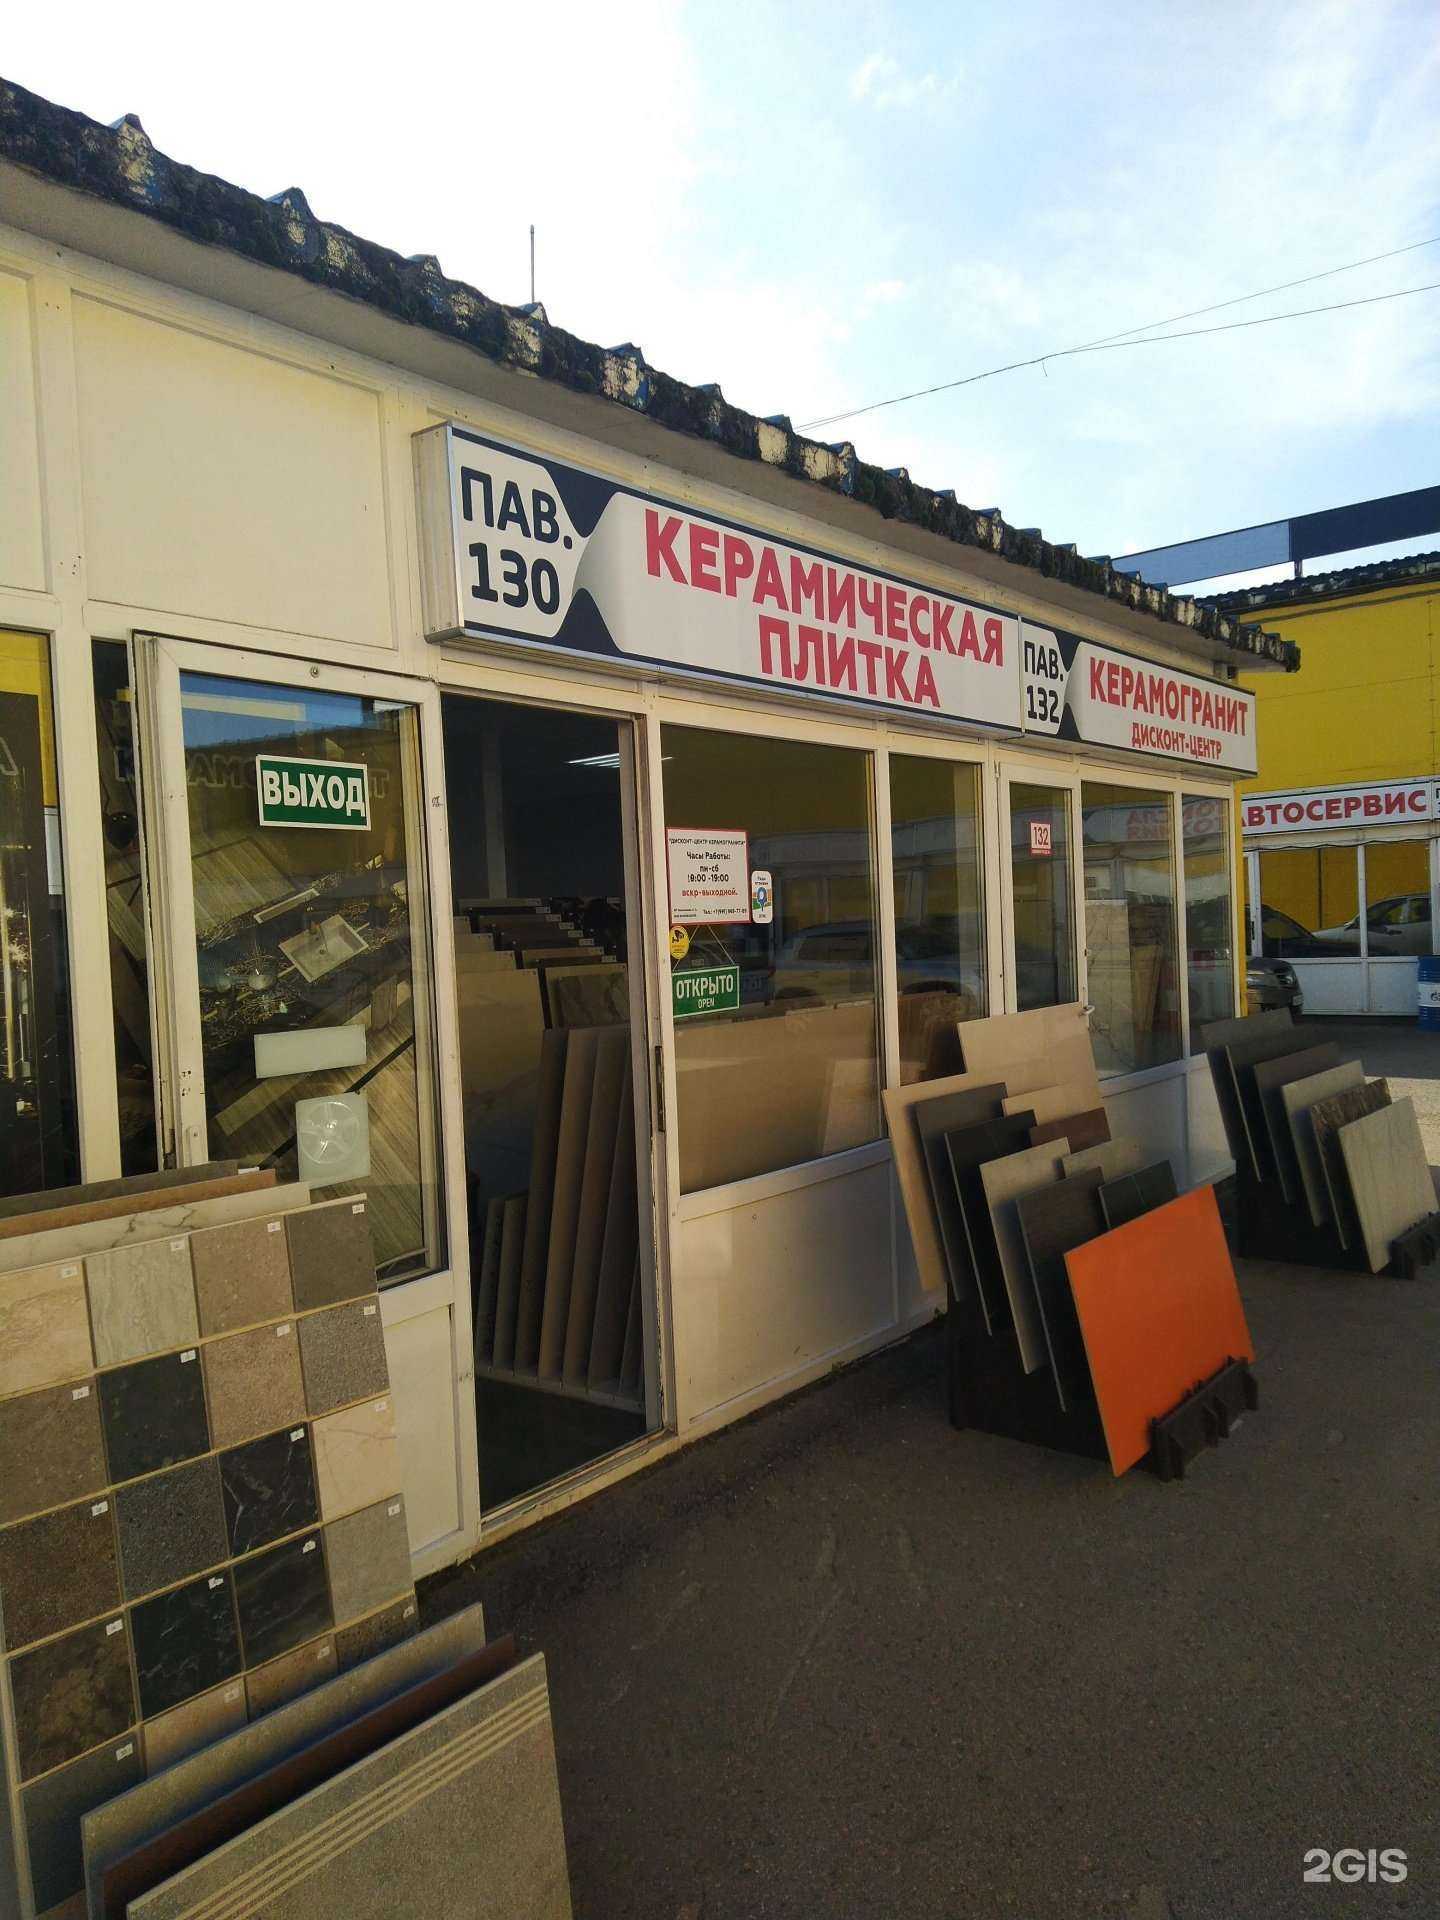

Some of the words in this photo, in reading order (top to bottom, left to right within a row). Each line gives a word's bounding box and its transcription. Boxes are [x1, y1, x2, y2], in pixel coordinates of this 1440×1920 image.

[461, 466, 574, 550] ПАВ.
[468, 542, 560, 616] 130
[645, 508, 1004, 668] КЕРАМИЧЕСКАЯ
[758, 614, 941, 708] ПЛИТКА
[1023, 640, 1064, 681] ПАВ.
[1026, 686, 1060, 724] 132
[1089, 656, 1249, 737] КЕРАМОГРАНИТ
[1131, 721, 1223, 761] ДИСКОНТ-ЦЕНТР
[261, 769, 366, 817] ВЫХОД
[686, 851, 704, 860] Часы
[705, 852, 731, 860] Работы:
[1033, 826, 1049, 846] 132
[676, 974, 734, 999] ОТКРЫТО
[697, 997, 715, 1009] OPEN
